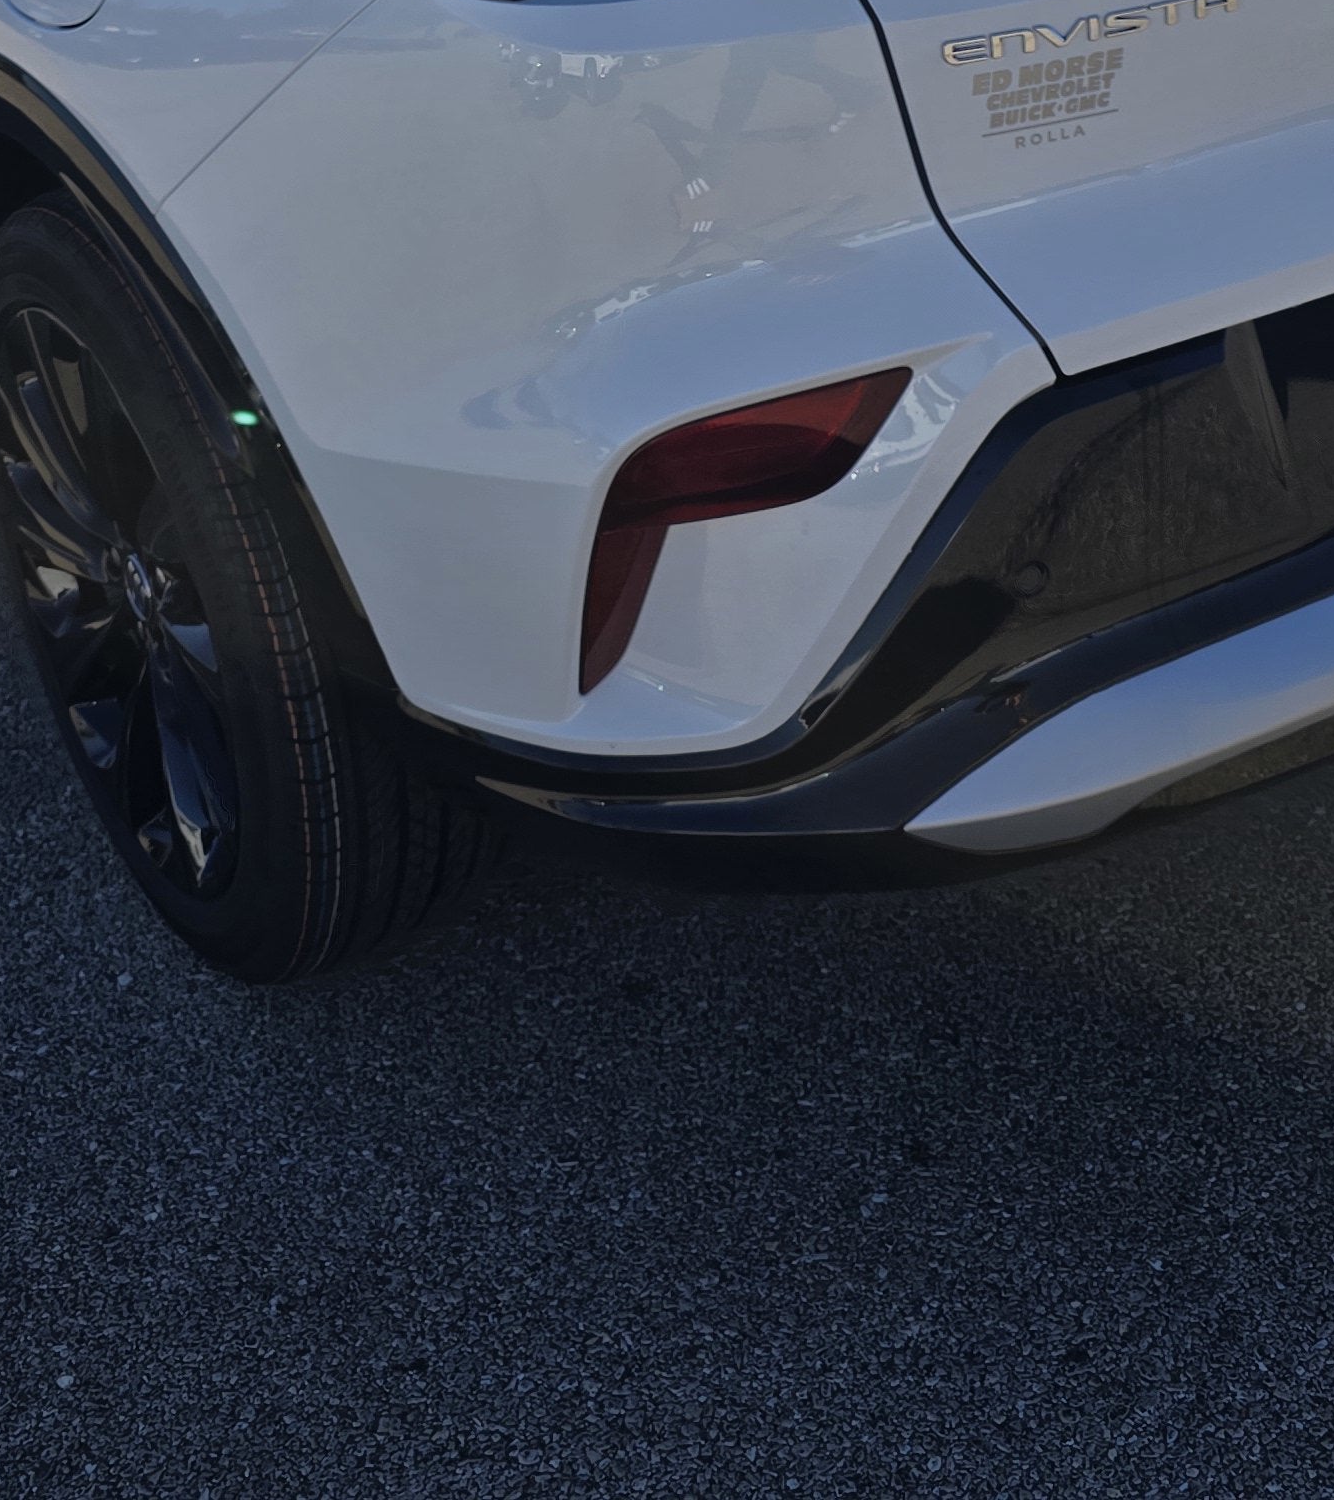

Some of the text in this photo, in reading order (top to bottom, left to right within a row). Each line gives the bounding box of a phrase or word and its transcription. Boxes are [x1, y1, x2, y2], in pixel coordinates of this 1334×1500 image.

[971, 47, 1124, 97] ED MORSE
[986, 71, 1116, 111] CHEVROLET
[1014, 124, 1086, 149] ROLLA
